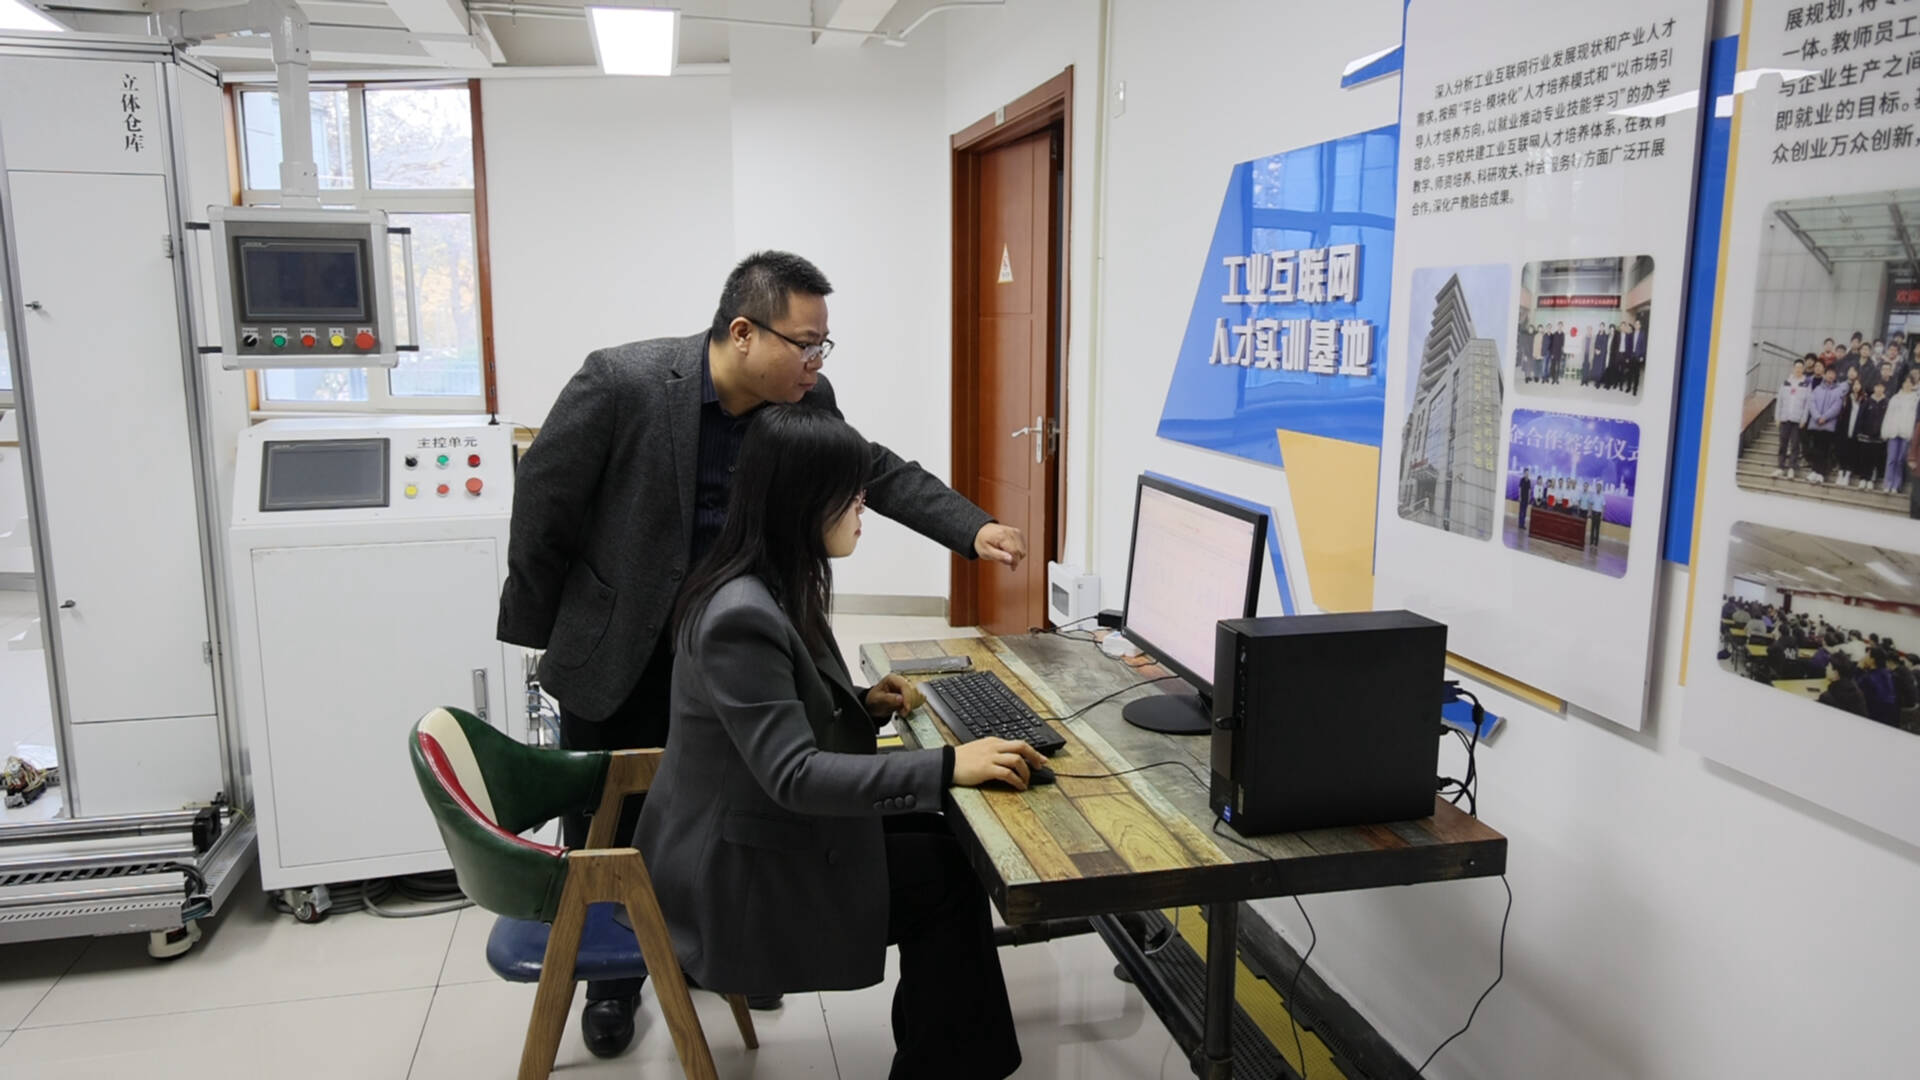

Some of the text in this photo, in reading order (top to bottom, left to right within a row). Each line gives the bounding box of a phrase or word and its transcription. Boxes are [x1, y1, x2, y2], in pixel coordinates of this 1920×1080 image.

[121, 73, 144, 153] 立体仓库
[1775, 88, 1920, 132] 即就业的目标。
[1221, 243, 1362, 305] 工业互联网
[1208, 317, 1373, 377] 人才实训基地
[417, 436, 478, 449] 主控单元
